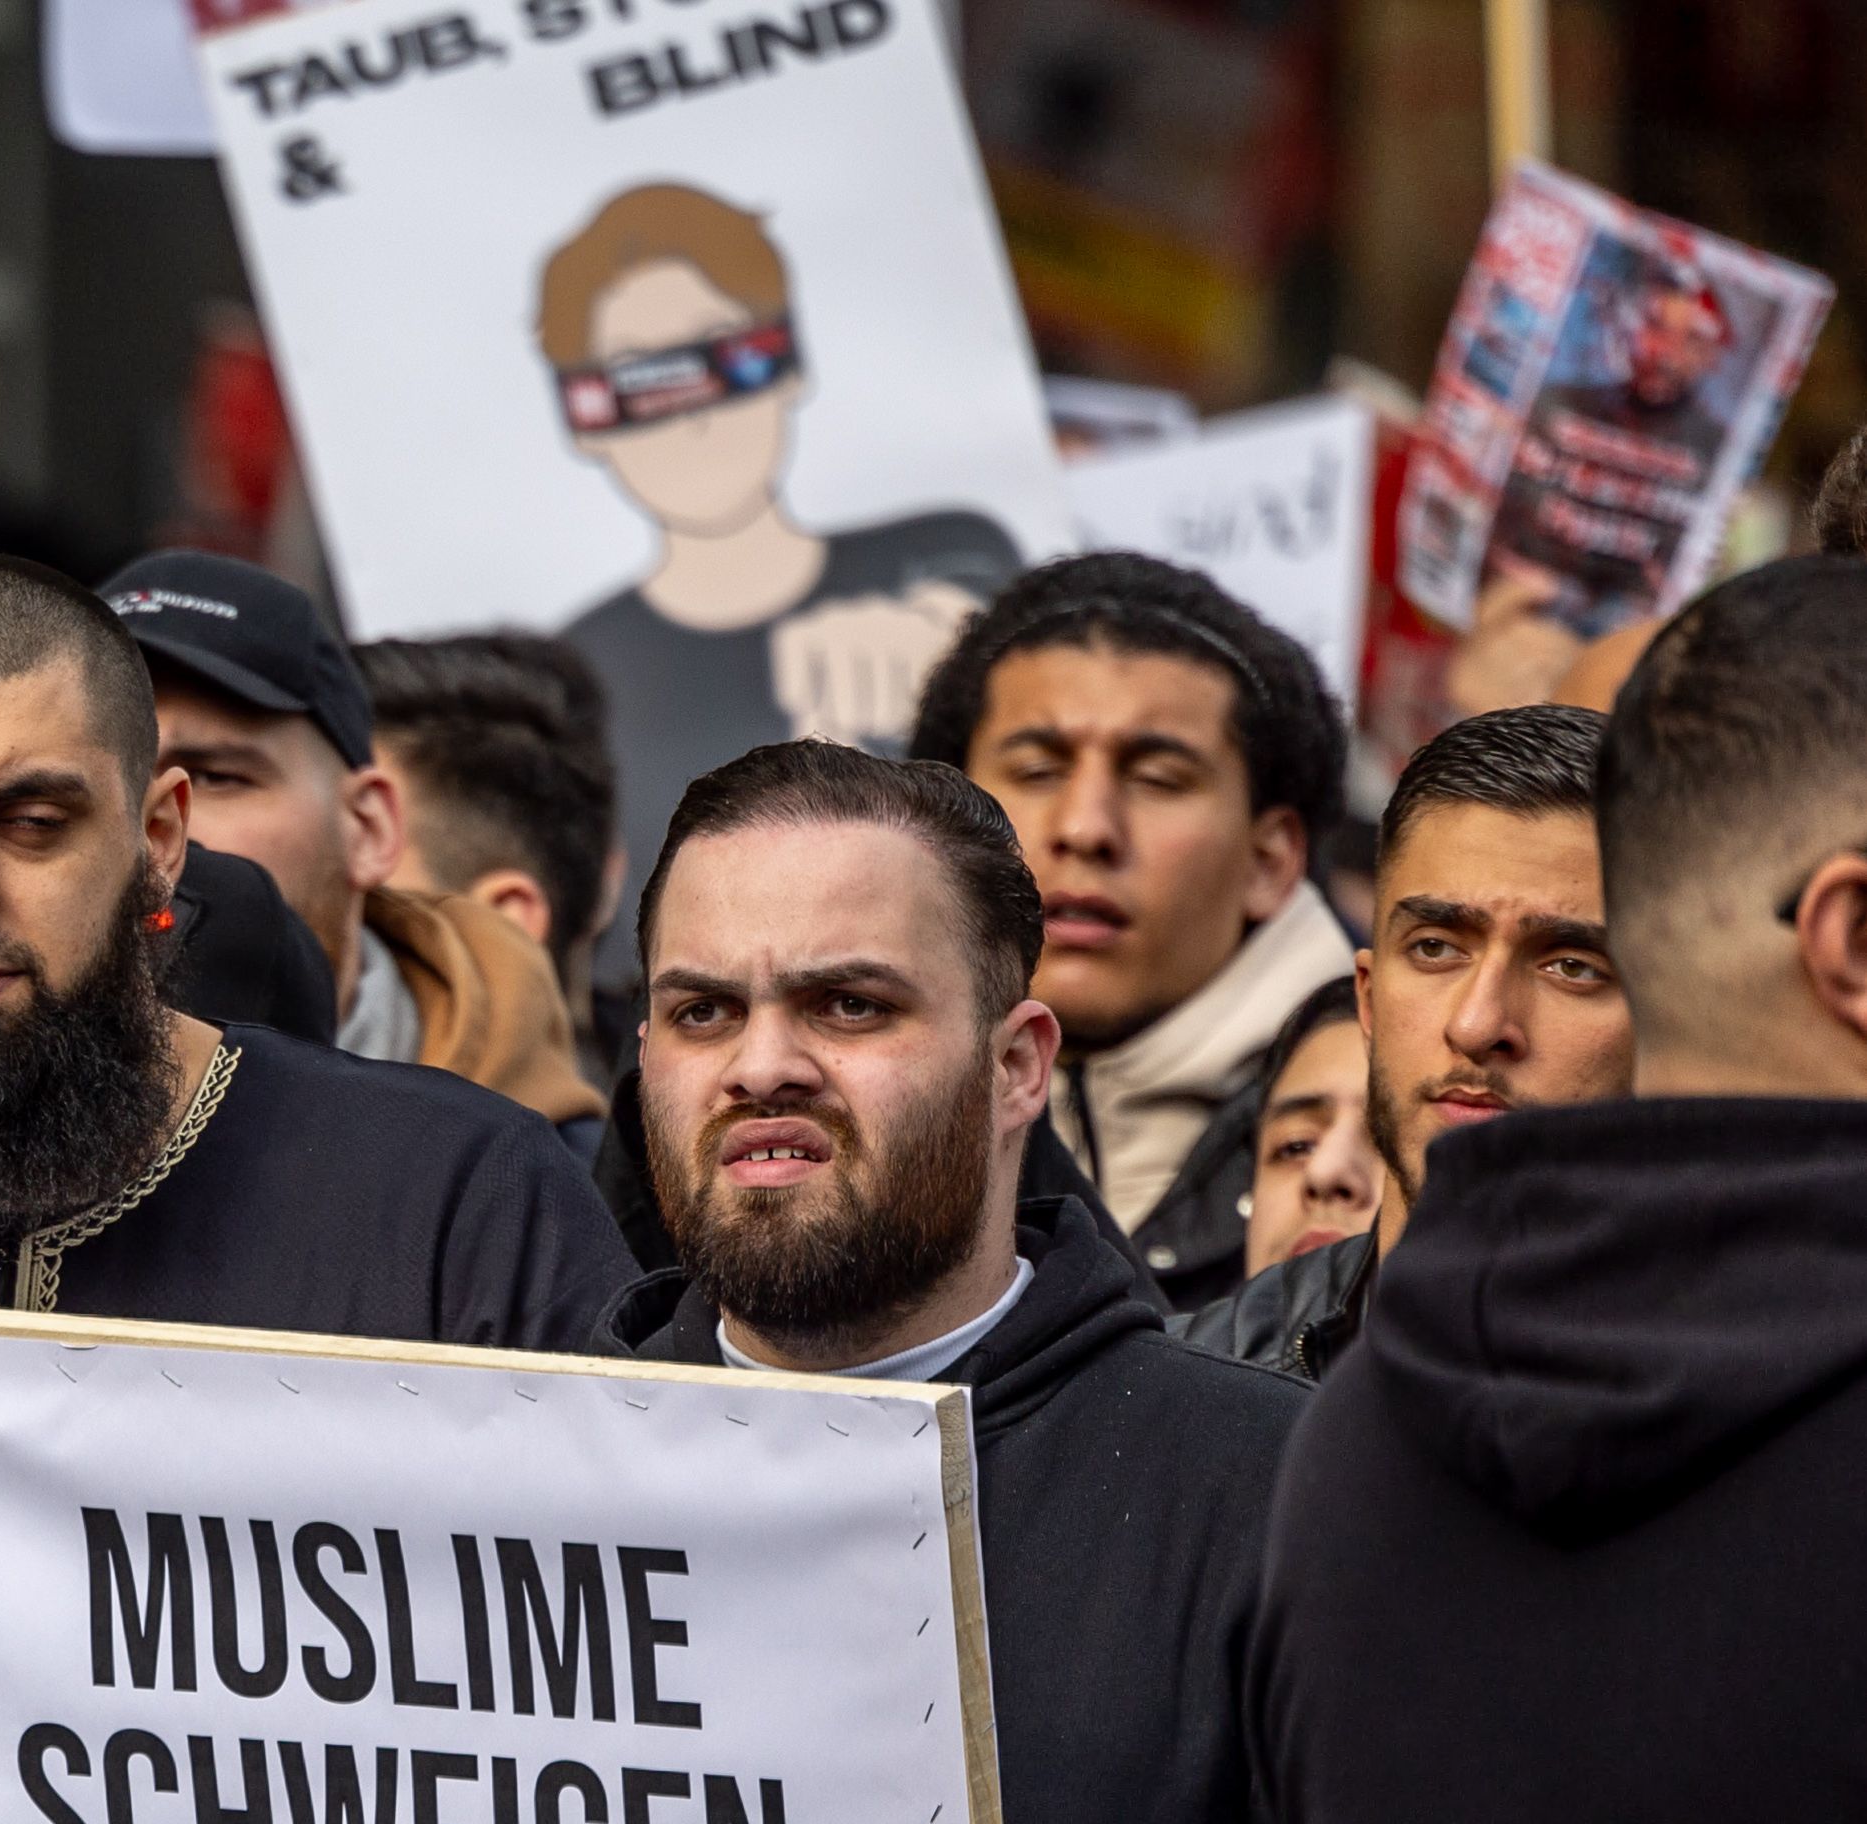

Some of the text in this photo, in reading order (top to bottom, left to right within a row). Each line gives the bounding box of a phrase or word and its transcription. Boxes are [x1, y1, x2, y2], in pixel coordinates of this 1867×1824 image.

[232, 12, 506, 118] TAUB,
[276, 134, 347, 203] &
[586, 0, 893, 118] BLIND
[80, 1506, 703, 1731] MUSLIME
